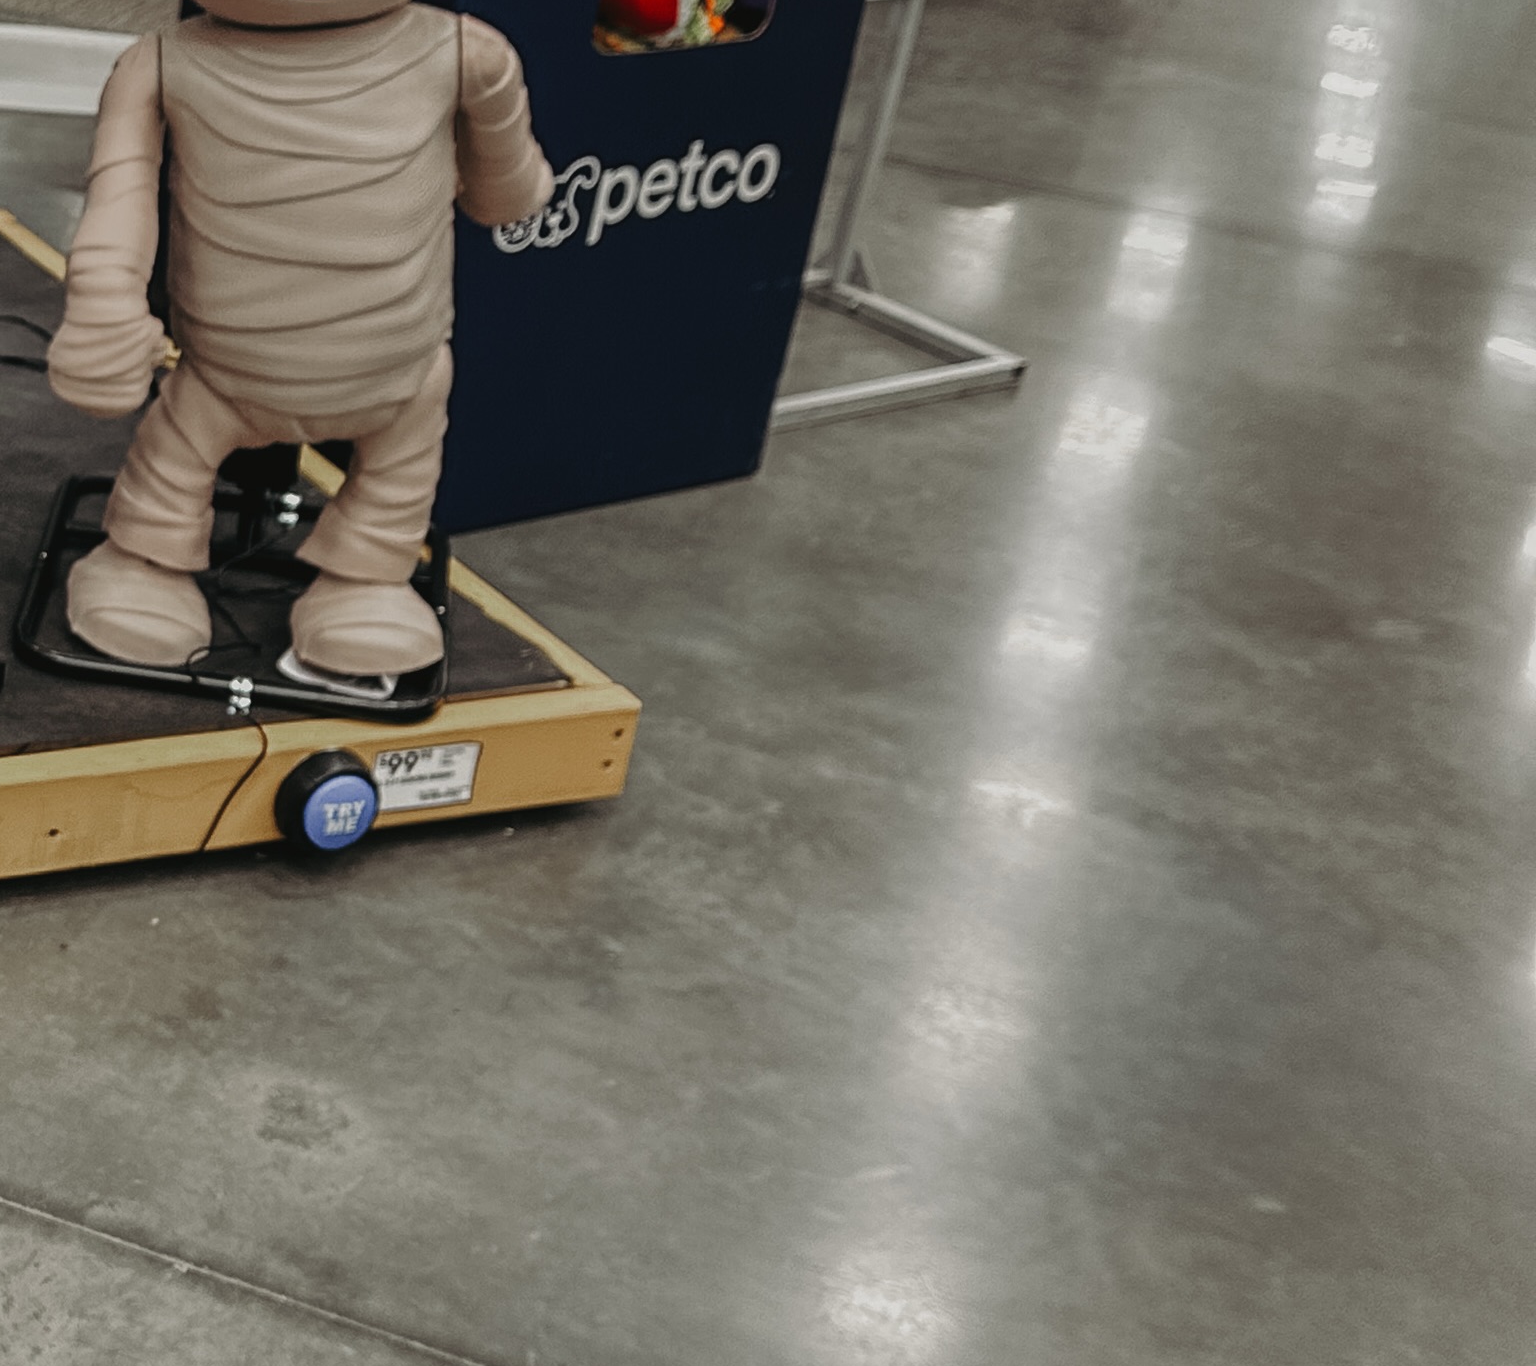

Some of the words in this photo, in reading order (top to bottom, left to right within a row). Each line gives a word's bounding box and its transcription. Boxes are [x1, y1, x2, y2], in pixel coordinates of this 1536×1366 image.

[584, 138, 782, 247] petco
[322, 799, 366, 819] TRY
[324, 817, 360, 836] ME
